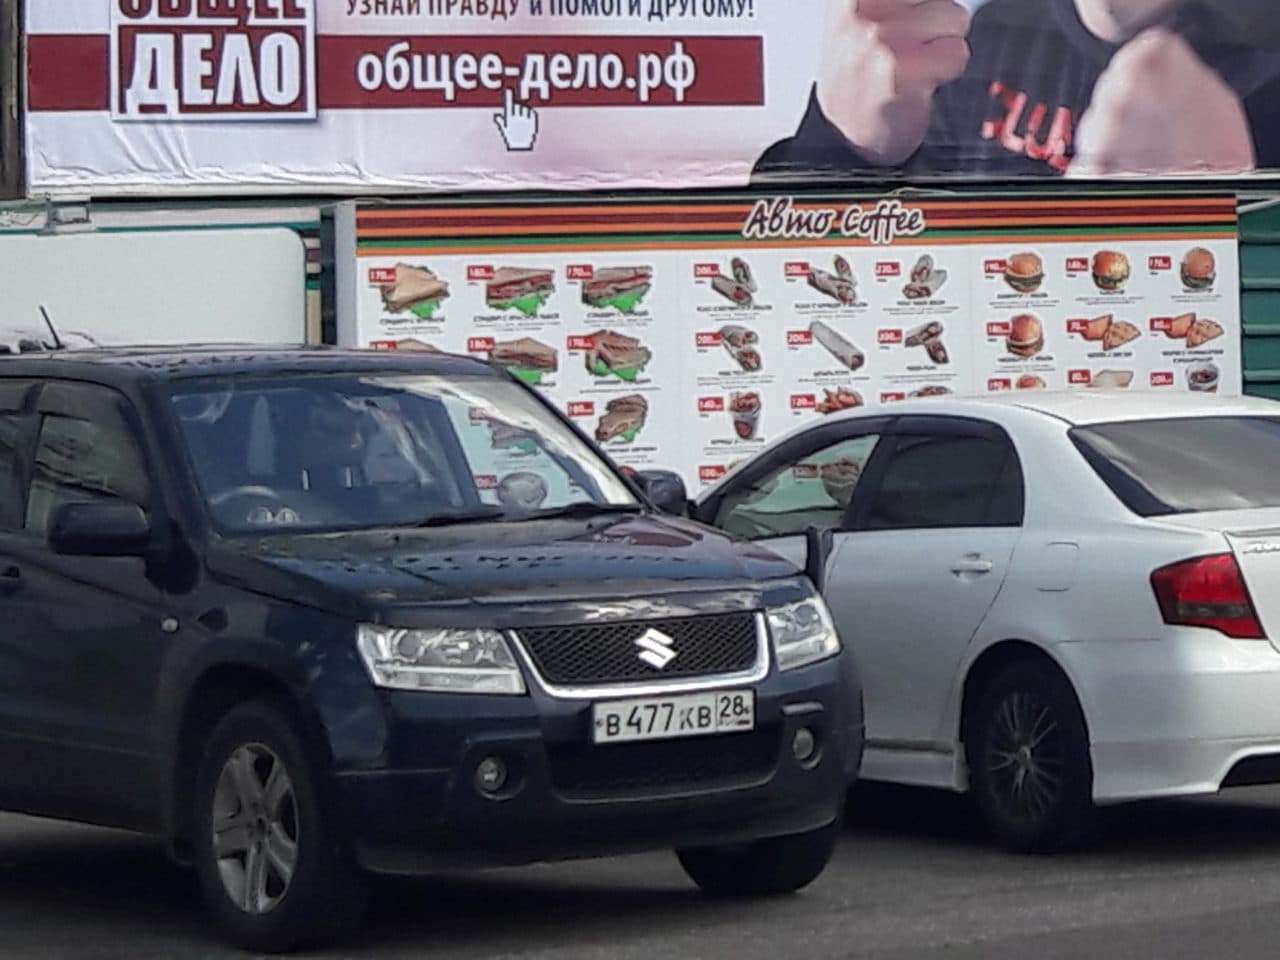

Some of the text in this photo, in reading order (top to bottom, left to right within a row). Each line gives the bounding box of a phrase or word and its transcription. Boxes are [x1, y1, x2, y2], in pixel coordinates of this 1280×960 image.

[126, 31, 301, 114] ДЕЛО
[356, 41, 696, 103] общее-дело.рф
[743, 196, 924, 243] Авто Coffee
[720, 695, 744, 718] 28
